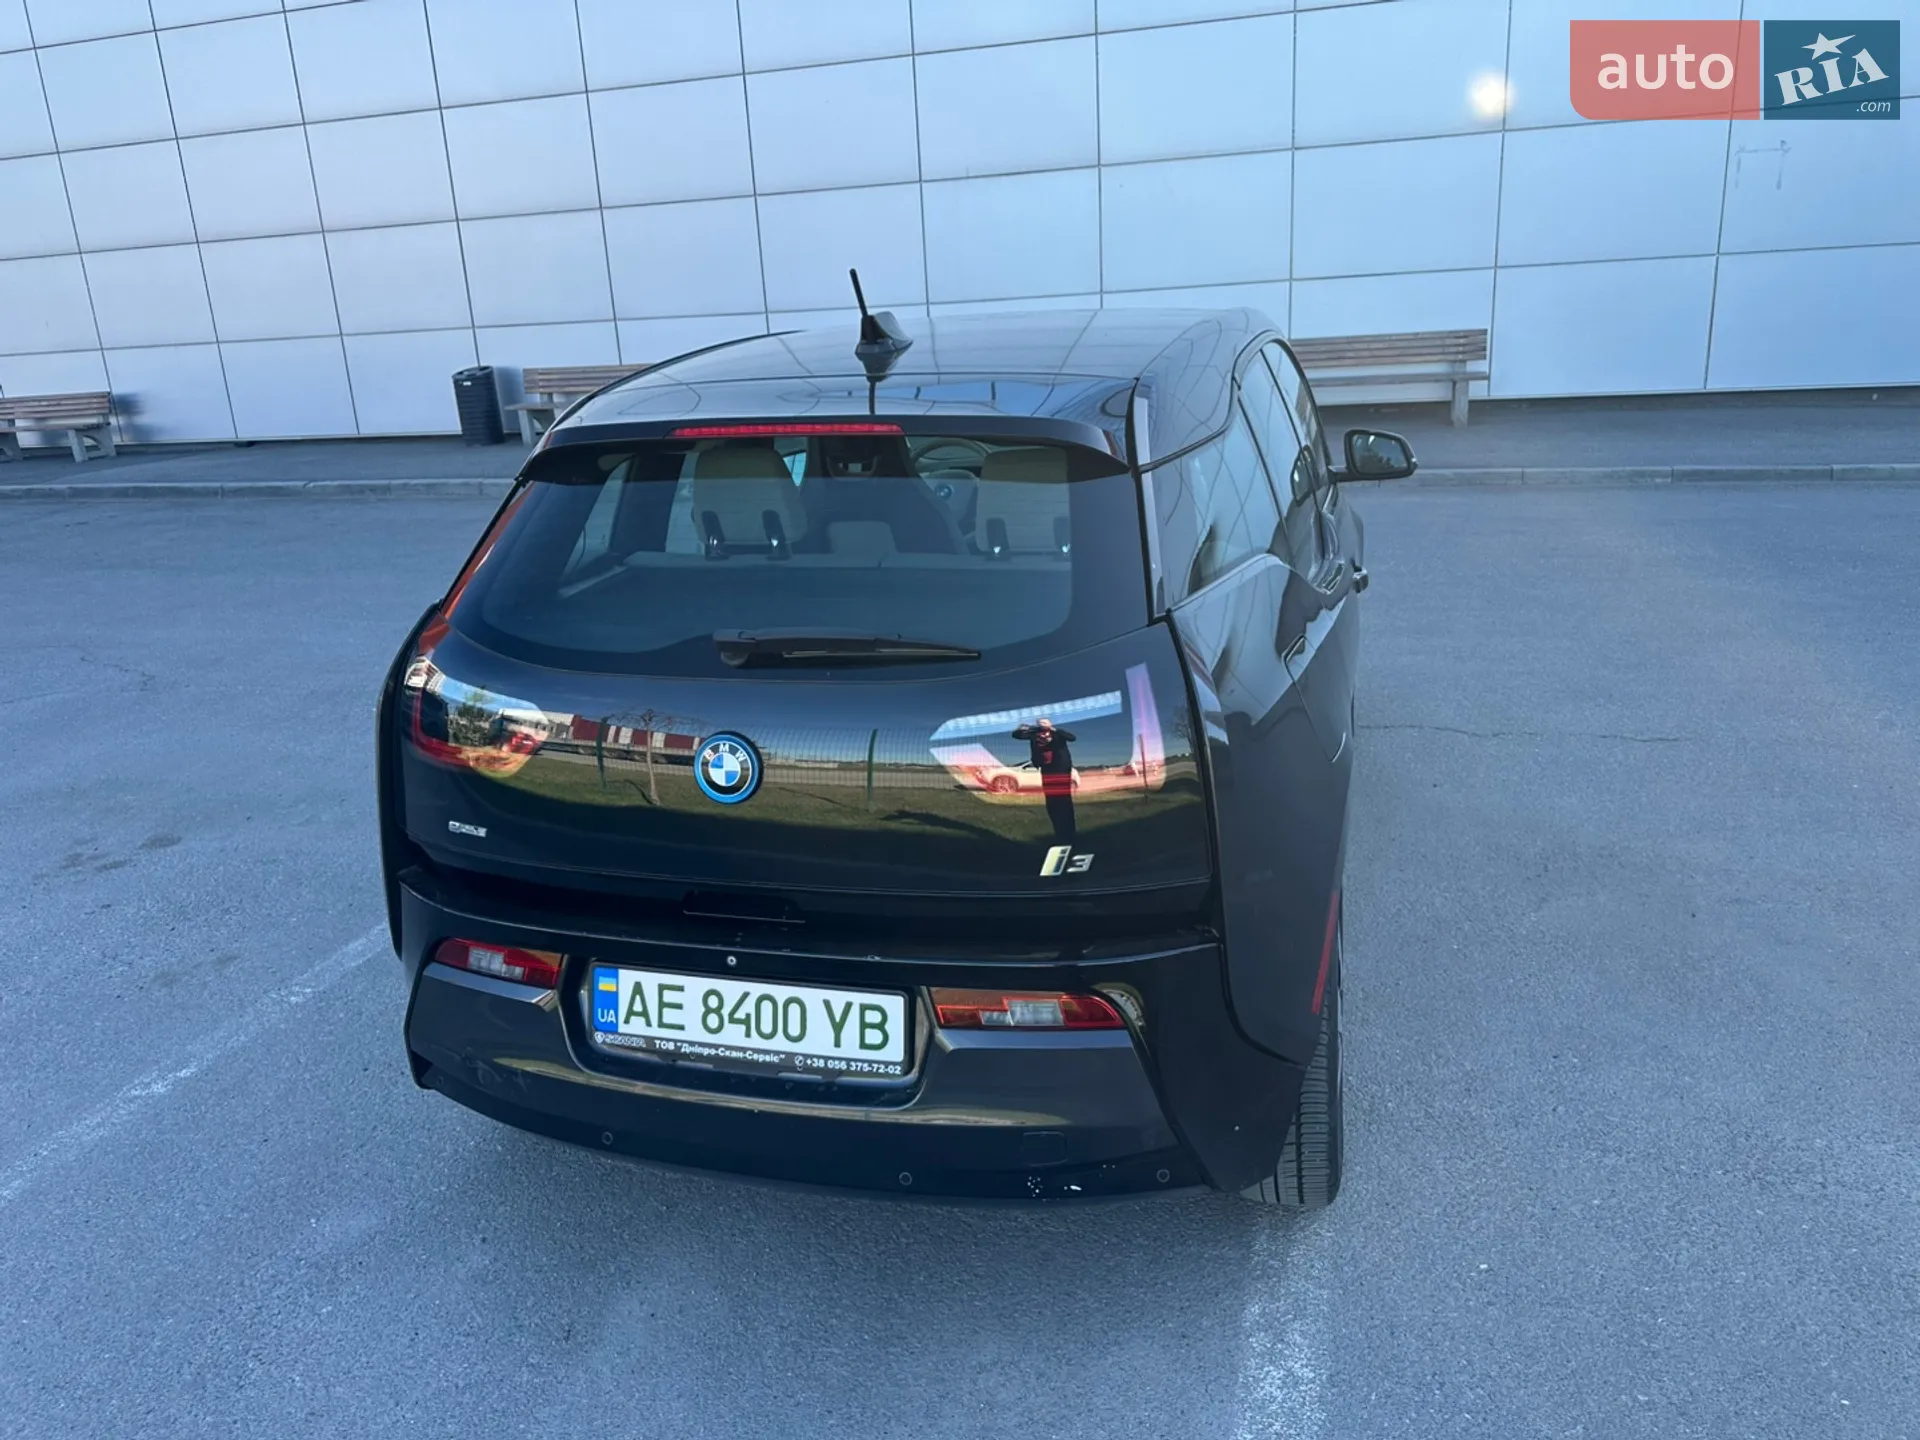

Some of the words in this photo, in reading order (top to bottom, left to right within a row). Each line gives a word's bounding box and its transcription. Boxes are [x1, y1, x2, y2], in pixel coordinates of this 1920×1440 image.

[703, 742, 747, 762] BMW
[1040, 845, 1095, 876] i3
[598, 1008, 616, 1023] UA
[623, 981, 686, 1031] AE
[701, 988, 807, 1043] 8400
[822, 998, 890, 1051] YB
[654, 1039, 675, 1050] ТОВ
[806, 1057, 826, 1067] +38
[827, 1060, 847, 1071] 056
[849, 1061, 902, 1075] 375-72-02
